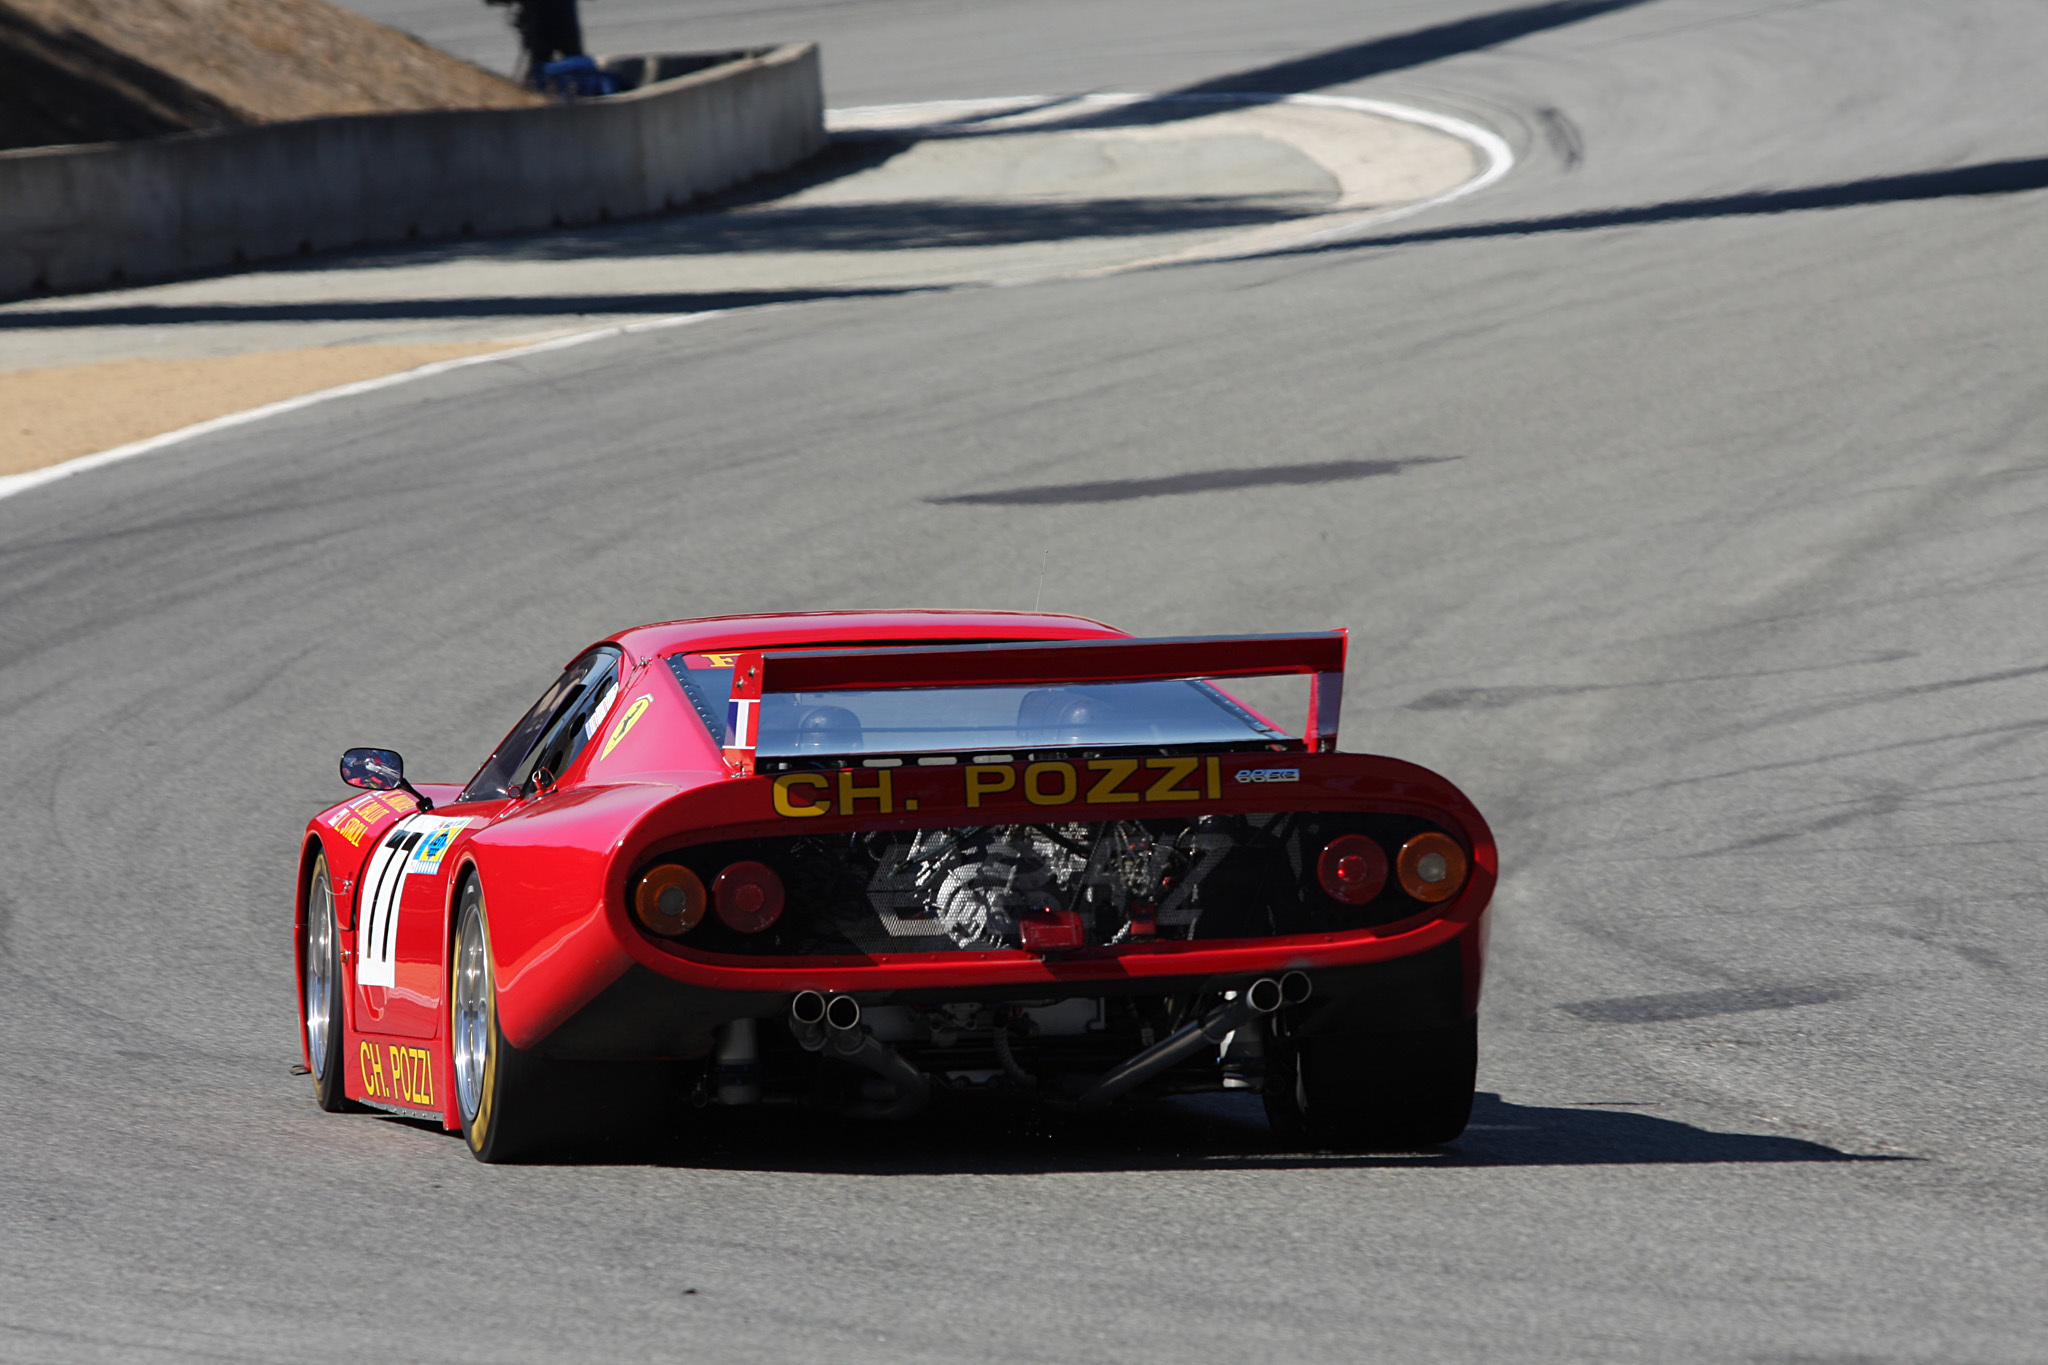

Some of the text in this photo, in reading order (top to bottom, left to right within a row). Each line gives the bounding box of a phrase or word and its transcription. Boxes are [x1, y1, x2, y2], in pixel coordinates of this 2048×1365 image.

[772, 755, 1223, 819] CH. POZZI
[360, 1040, 435, 1106] CH. POZZI
